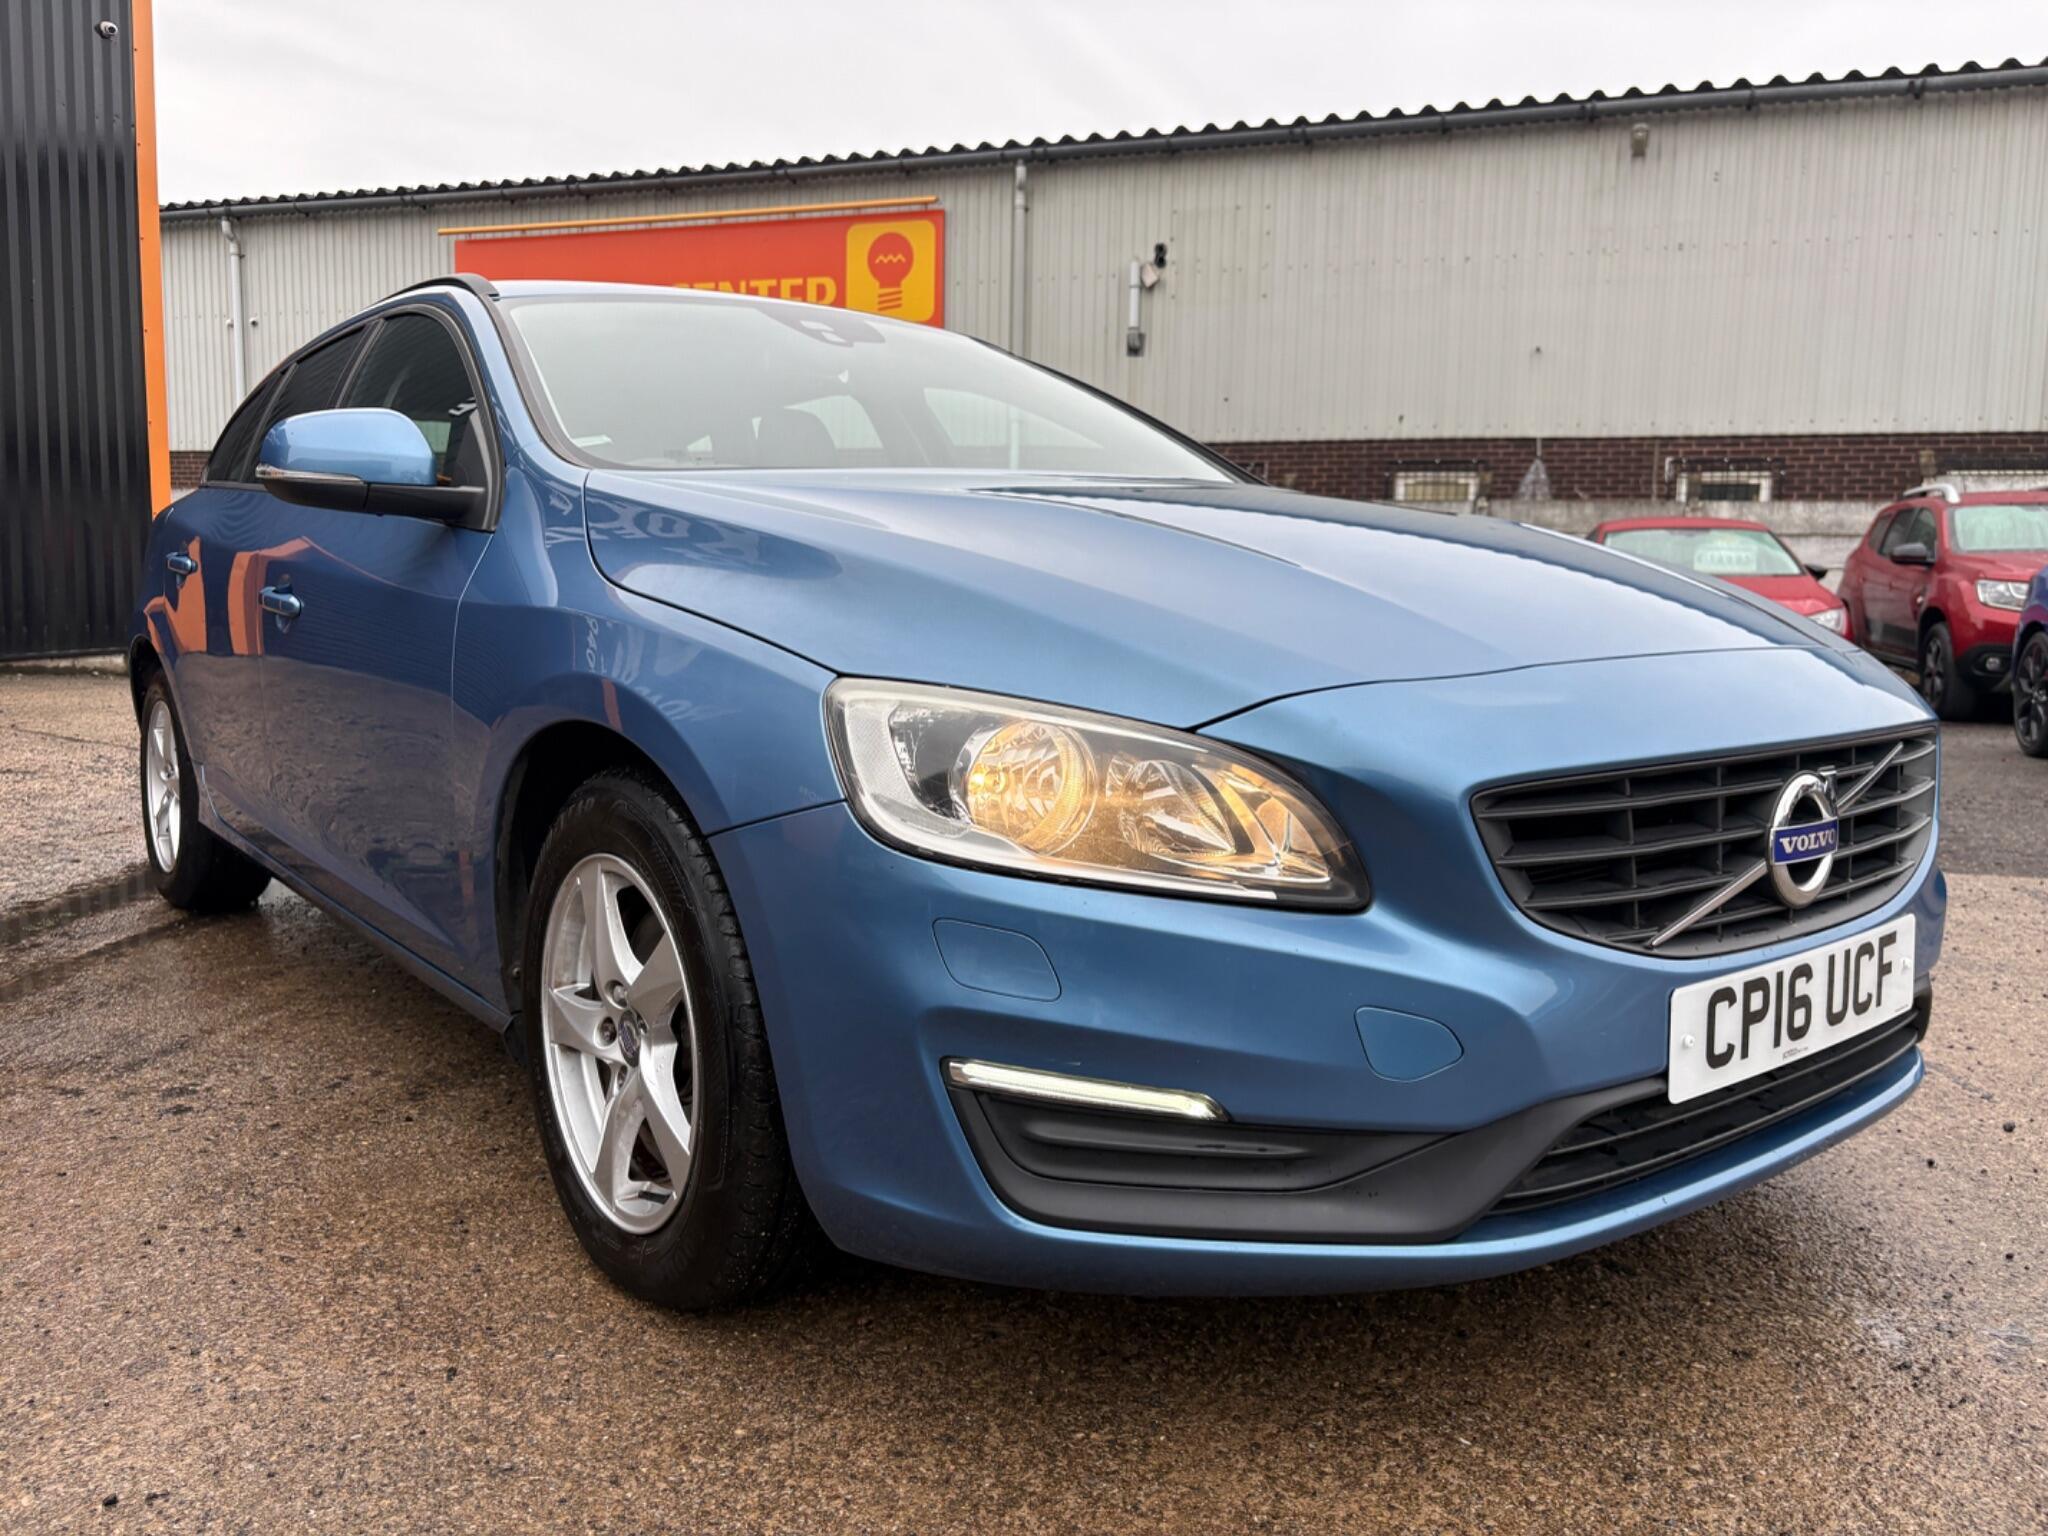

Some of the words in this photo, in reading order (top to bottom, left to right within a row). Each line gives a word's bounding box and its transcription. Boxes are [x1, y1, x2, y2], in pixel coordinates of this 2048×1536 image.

[1780, 828, 1836, 854] VOLVO
[1706, 963, 1813, 1069] CP16
[1826, 930, 1897, 1026] UCF
